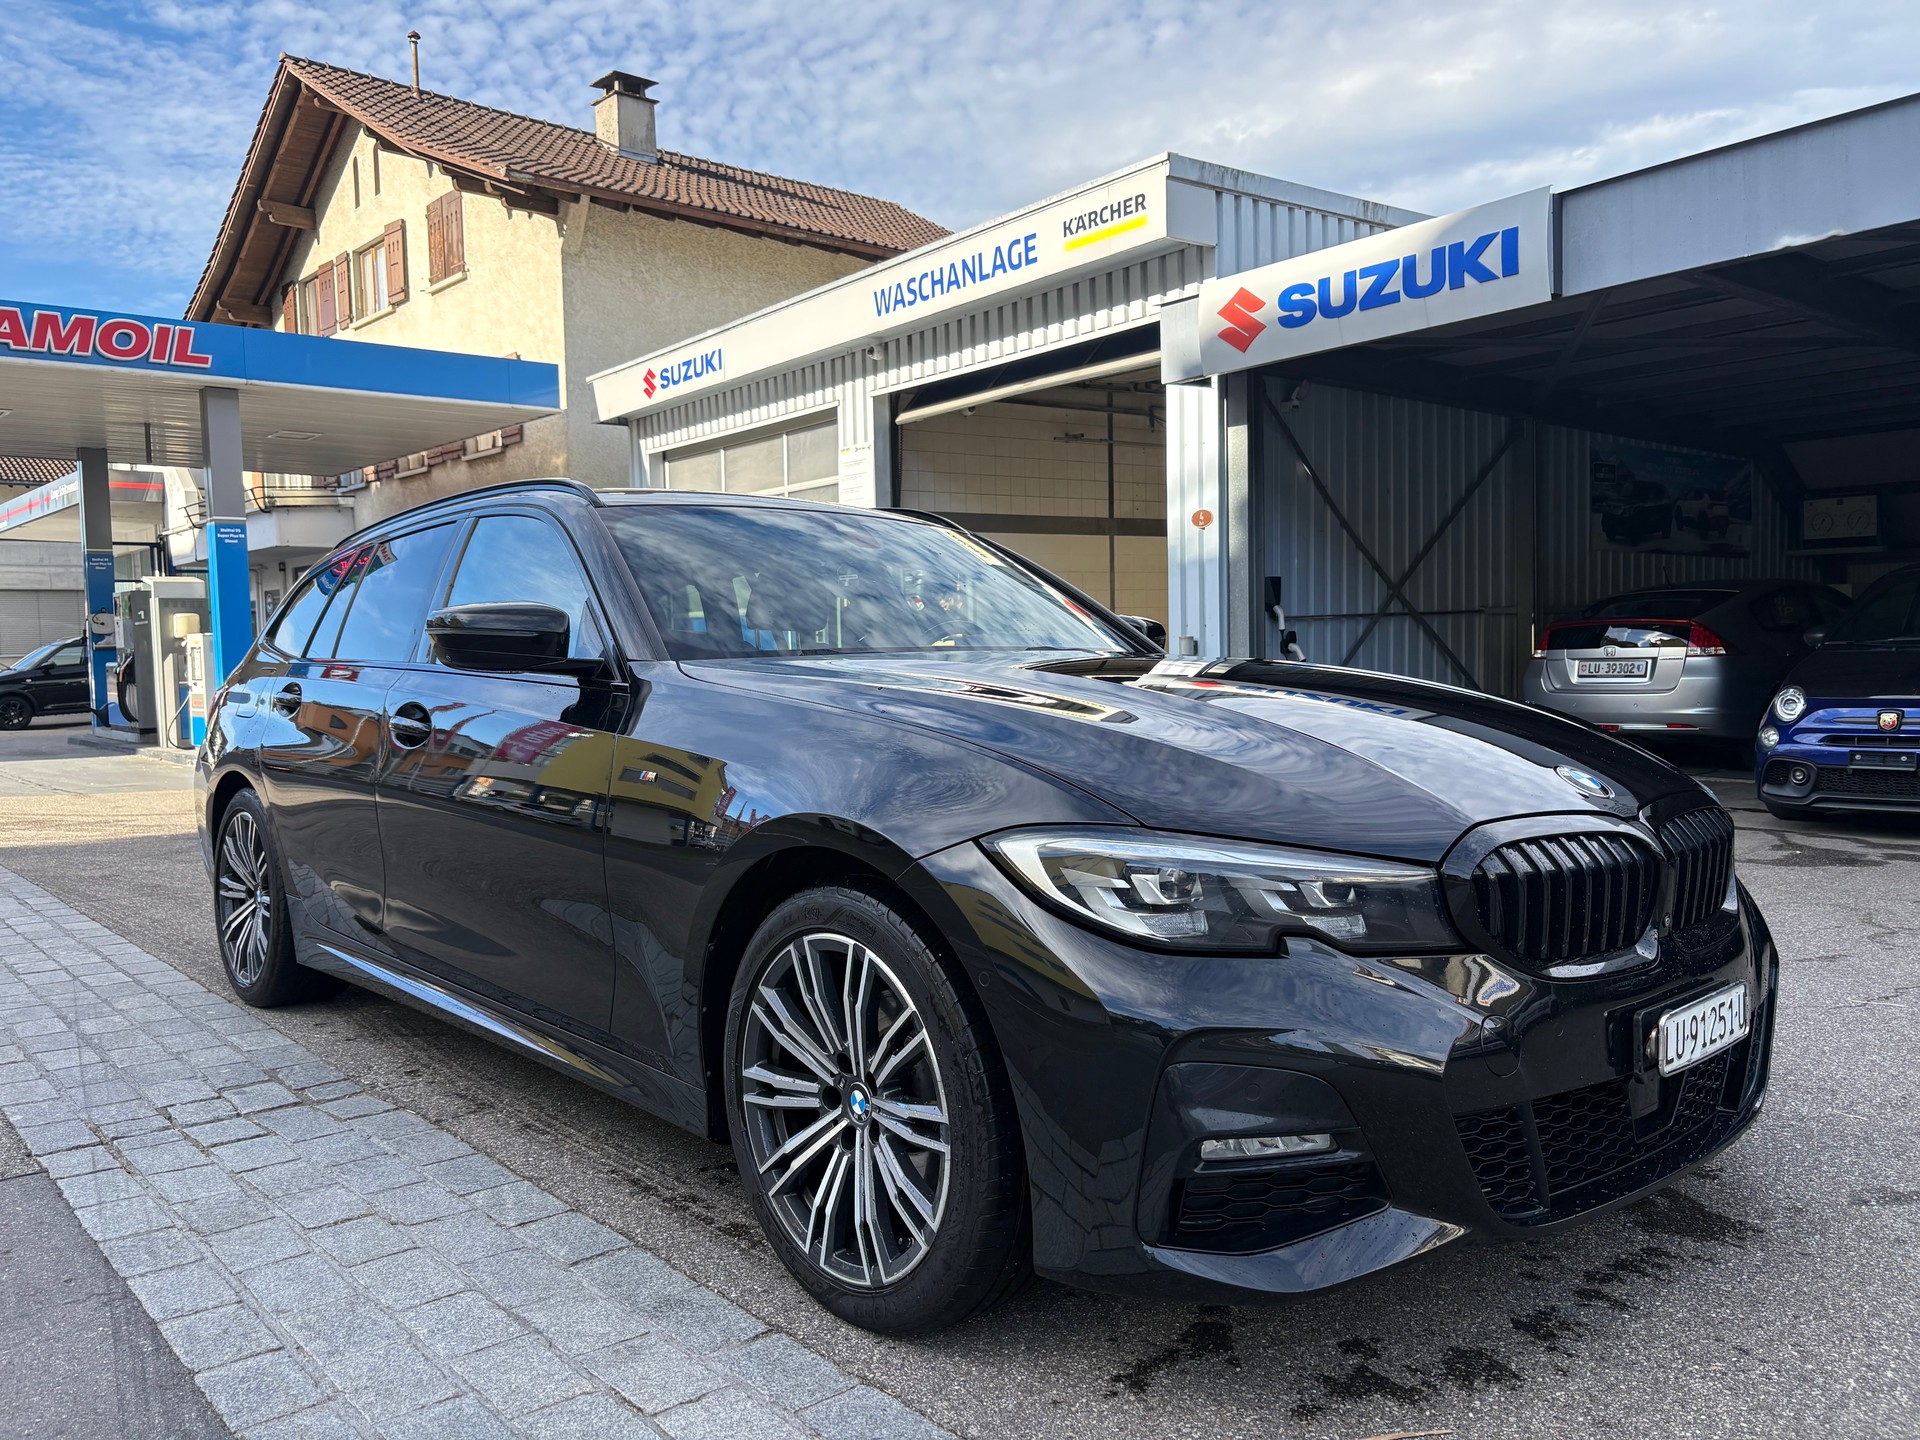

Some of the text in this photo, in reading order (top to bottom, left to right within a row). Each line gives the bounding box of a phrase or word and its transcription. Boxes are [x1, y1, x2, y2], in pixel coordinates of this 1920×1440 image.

[1063, 193, 1147, 238] KÄRCHER
[873, 232, 1039, 318] WASCHANLAGE
[1277, 226, 1519, 329] SUZUKI
[659, 348, 723, 390] SUZUKI
[137, 610, 145, 619] 1
